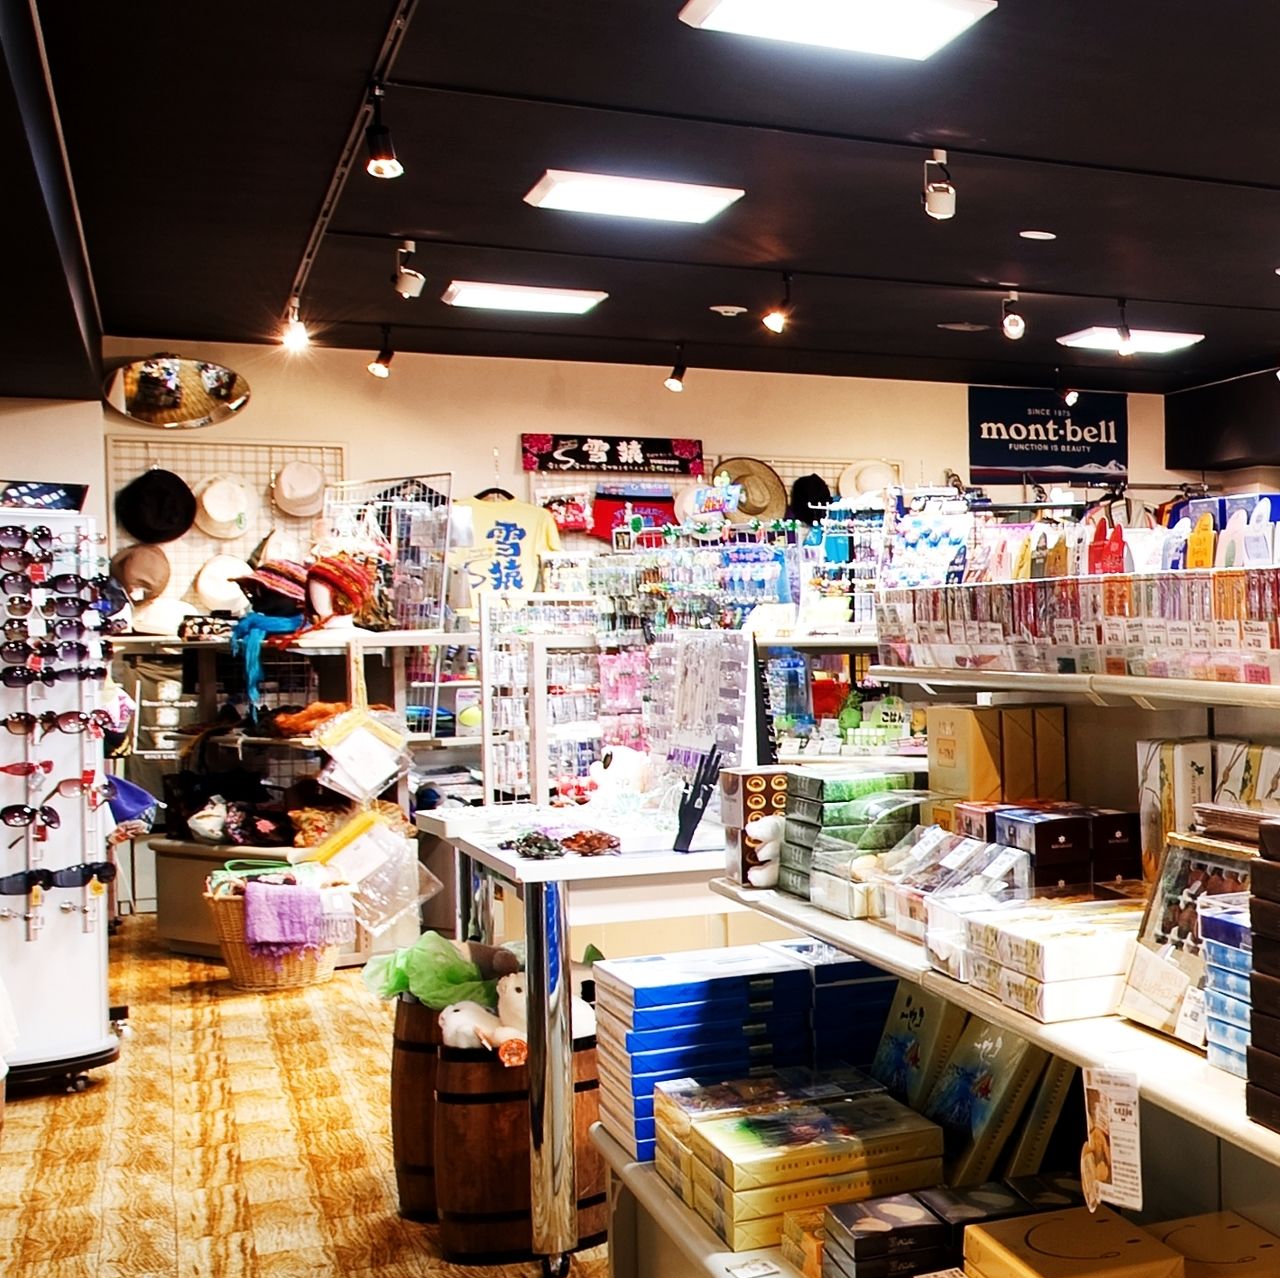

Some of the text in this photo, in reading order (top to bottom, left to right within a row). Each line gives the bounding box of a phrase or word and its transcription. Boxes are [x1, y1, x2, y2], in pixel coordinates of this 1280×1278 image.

[1027, 408, 1071, 416] SINCE 1975
[582, 438, 645, 464] 雪猿
[1008, 443, 1049, 451] FUNCTION
[1061, 445, 1091, 453] BEAUTY
[486, 520, 527, 590] 雪猿
